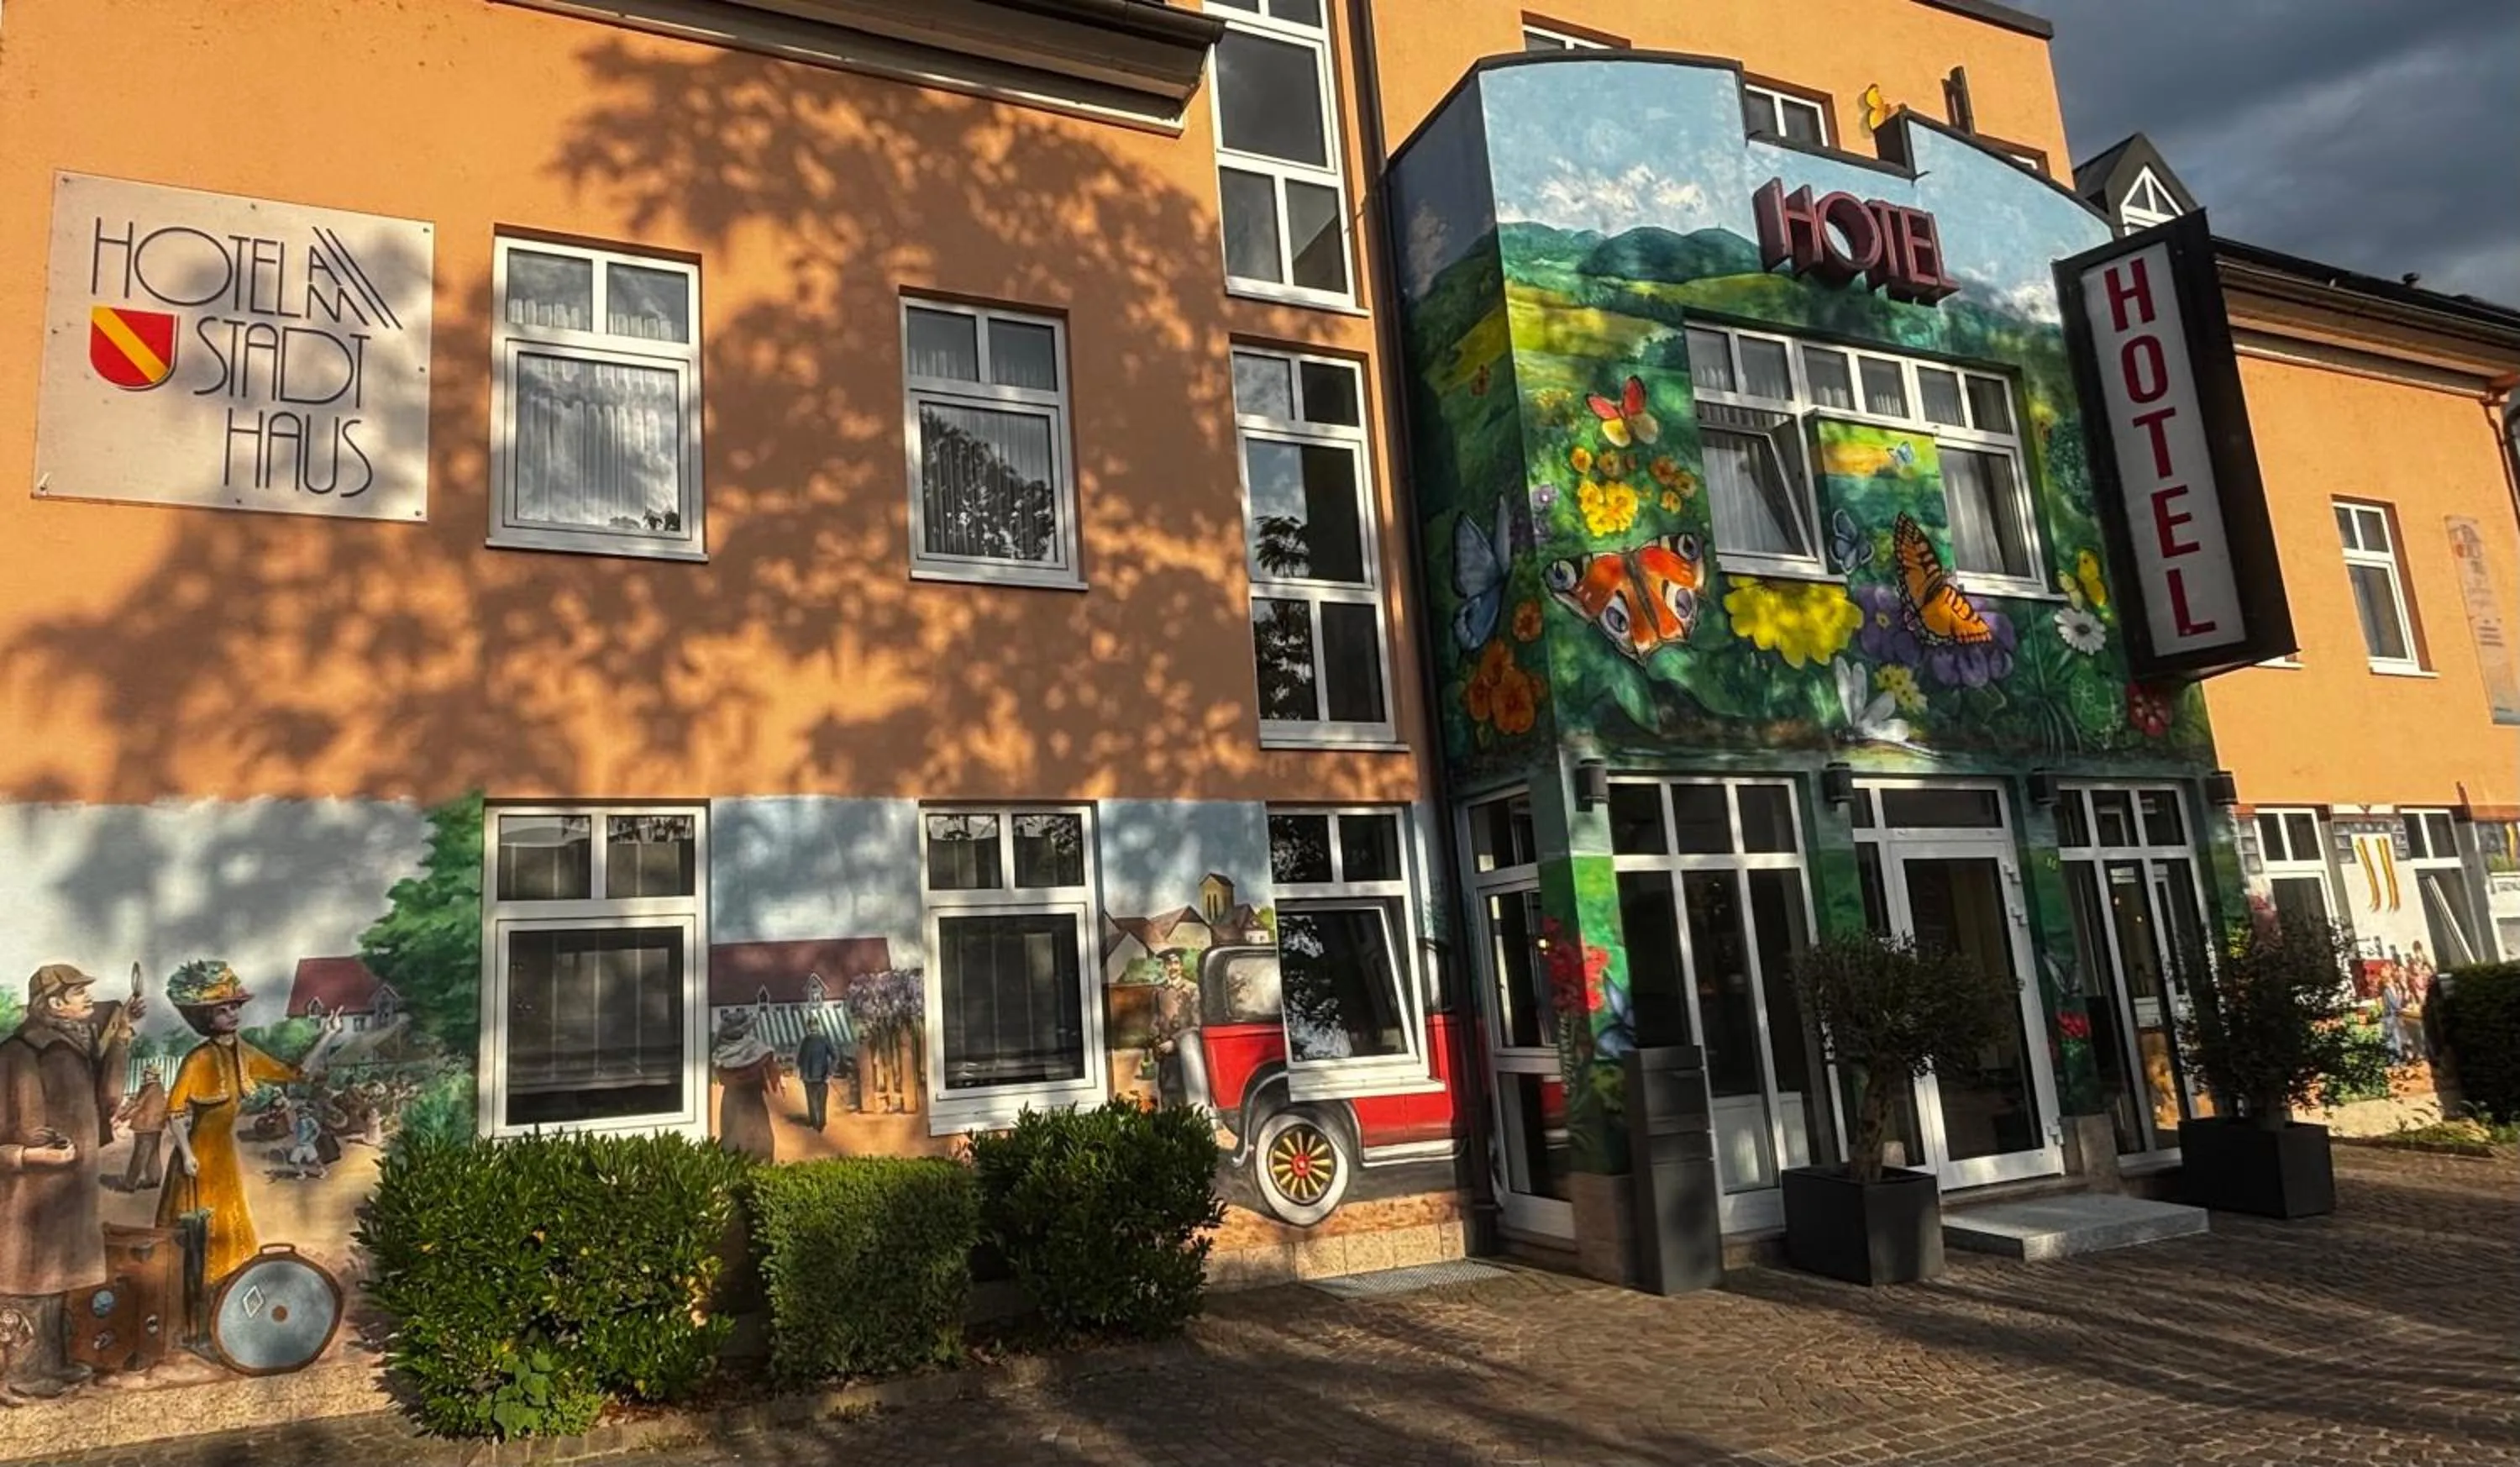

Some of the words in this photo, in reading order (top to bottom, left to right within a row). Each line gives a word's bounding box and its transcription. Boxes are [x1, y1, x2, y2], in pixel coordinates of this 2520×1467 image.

[91, 216, 302, 318] HOTEL
[1751, 176, 1962, 307] HOTEL
[193, 316, 371, 408] STADT
[223, 408, 373, 497] HAUS
[2103, 257, 2216, 638] HOTEL
